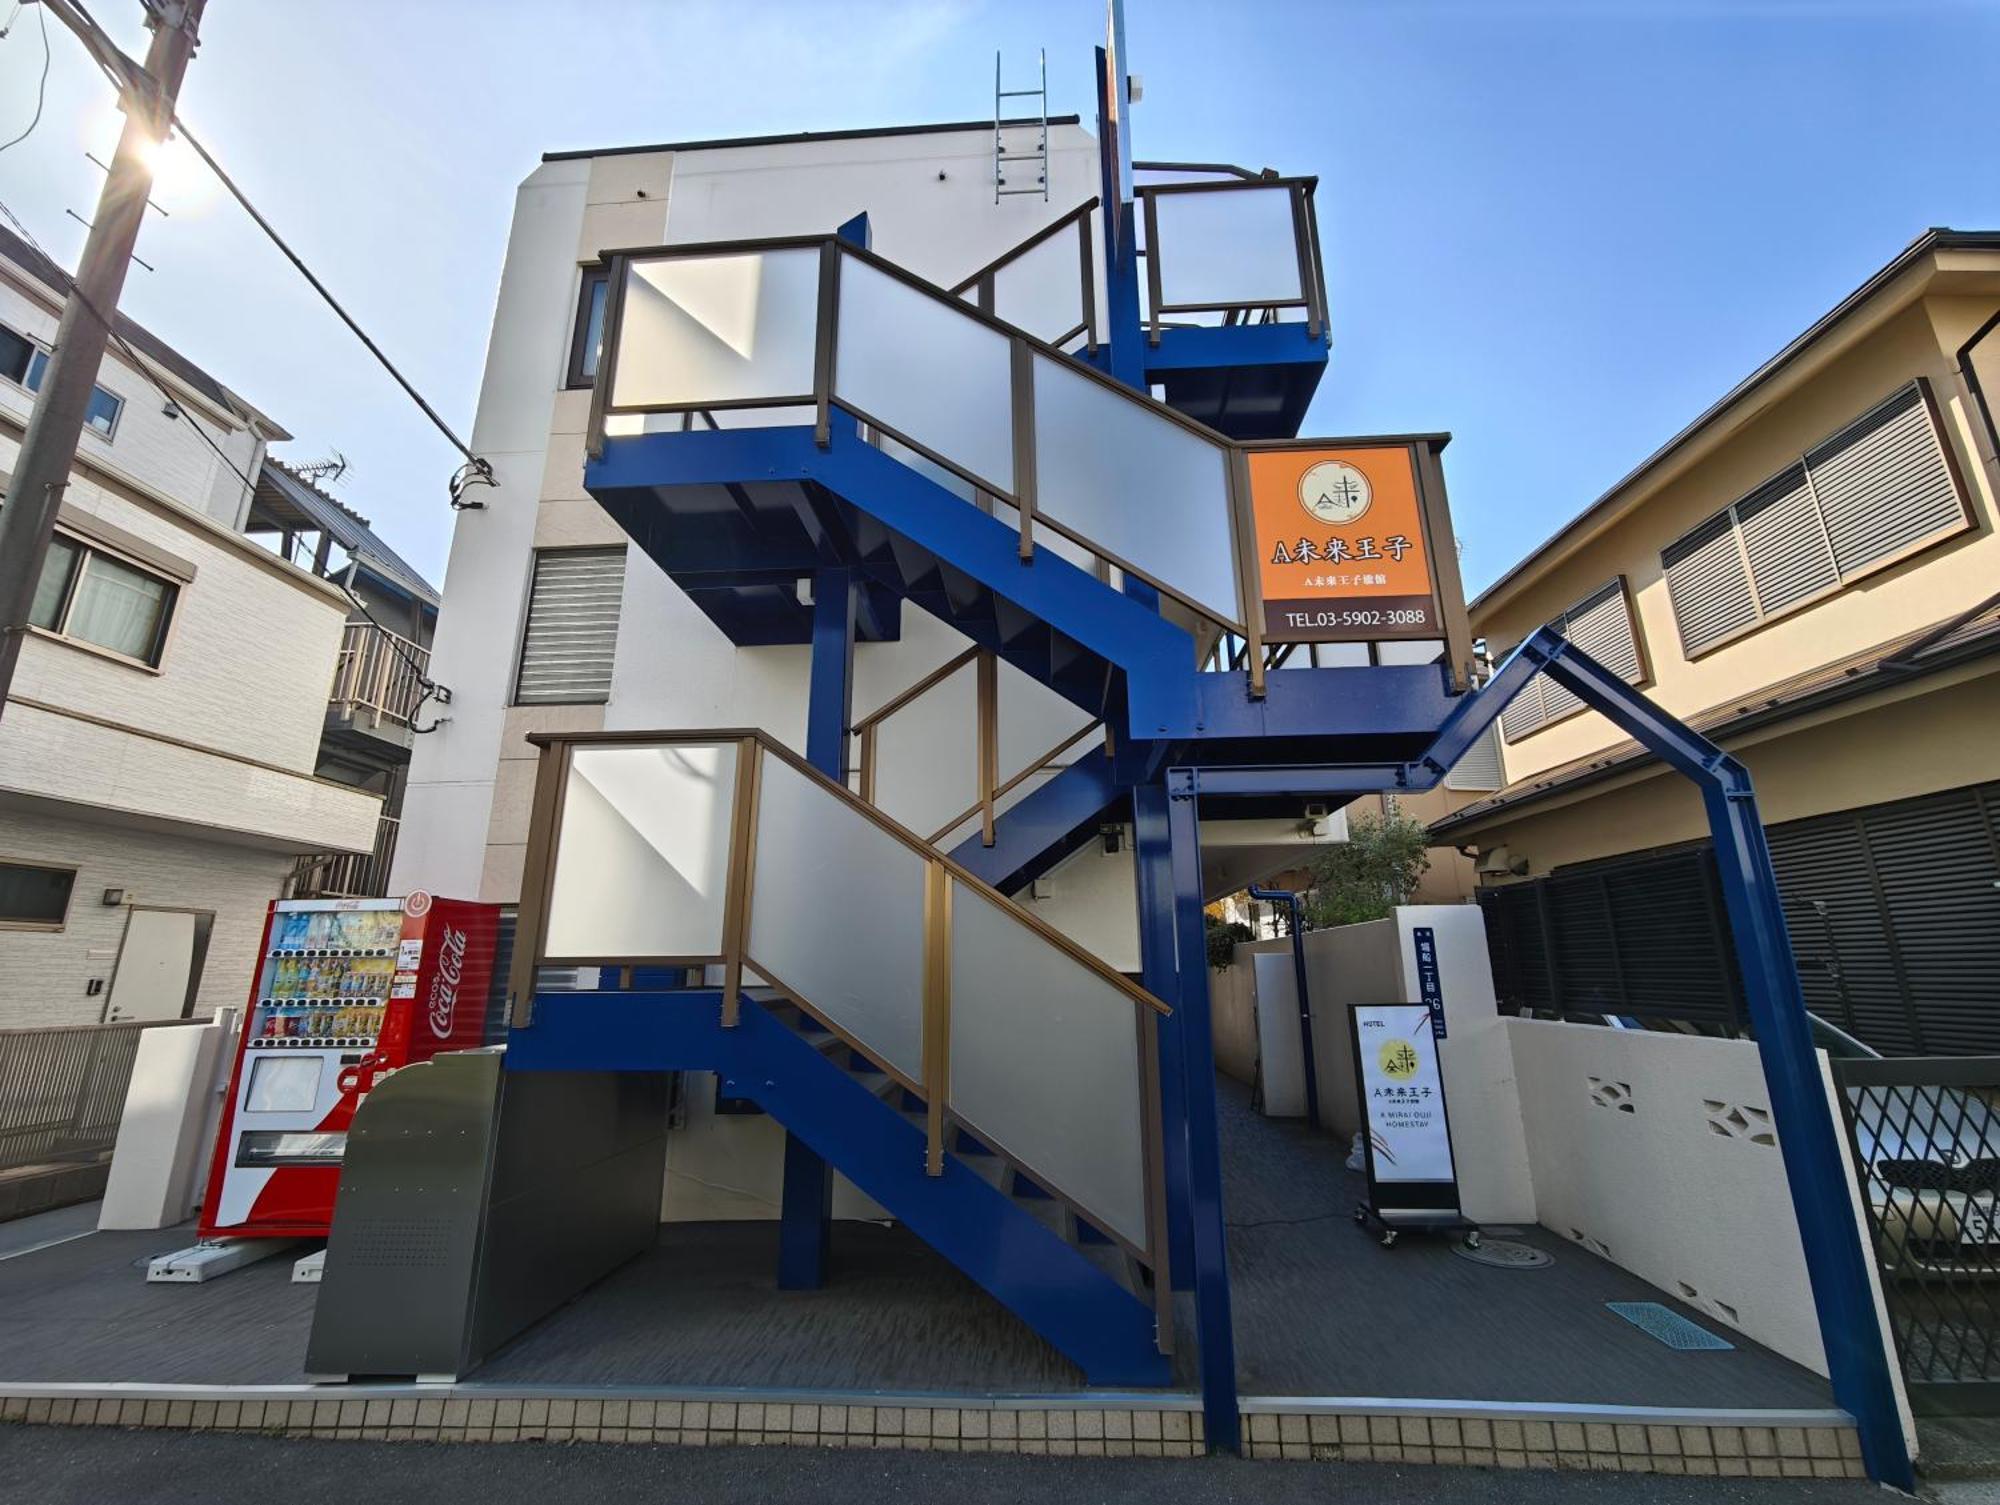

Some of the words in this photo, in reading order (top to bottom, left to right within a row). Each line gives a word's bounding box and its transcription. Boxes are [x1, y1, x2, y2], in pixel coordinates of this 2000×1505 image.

[1271, 535, 1413, 565] A未来王子
[1285, 609, 1426, 628] TEL.03-5902-3088
[429, 922, 468, 1039] Coca-Cola
[1363, 1020, 1386, 1028] HOTEL
[1374, 1087, 1432, 1098] A未来王子
[1386, 1120, 1429, 1128] HOMESTAY
